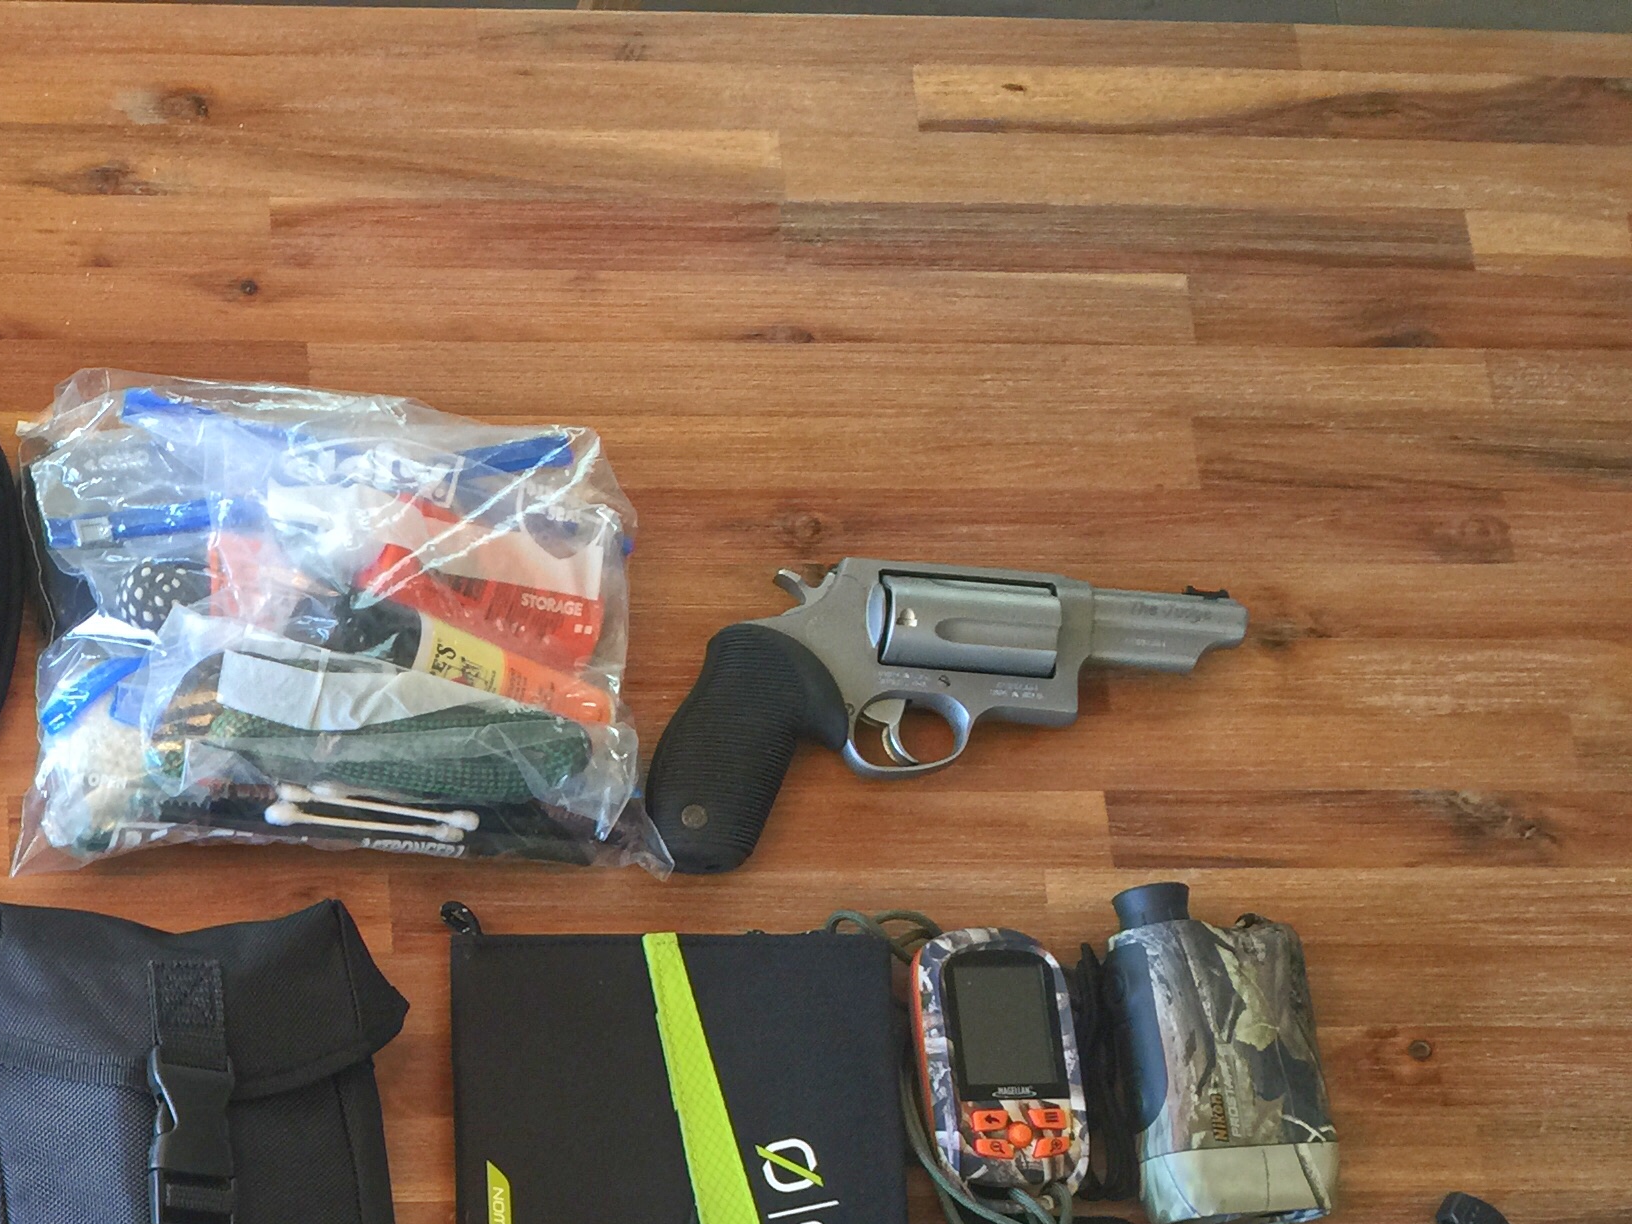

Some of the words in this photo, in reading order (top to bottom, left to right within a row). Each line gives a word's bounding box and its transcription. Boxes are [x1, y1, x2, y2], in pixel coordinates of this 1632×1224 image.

[521, 592, 585, 617] STORAGE
[997, 1086, 1032, 1095] MAGELLAN
[1210, 1093, 1229, 1142] Nikon
